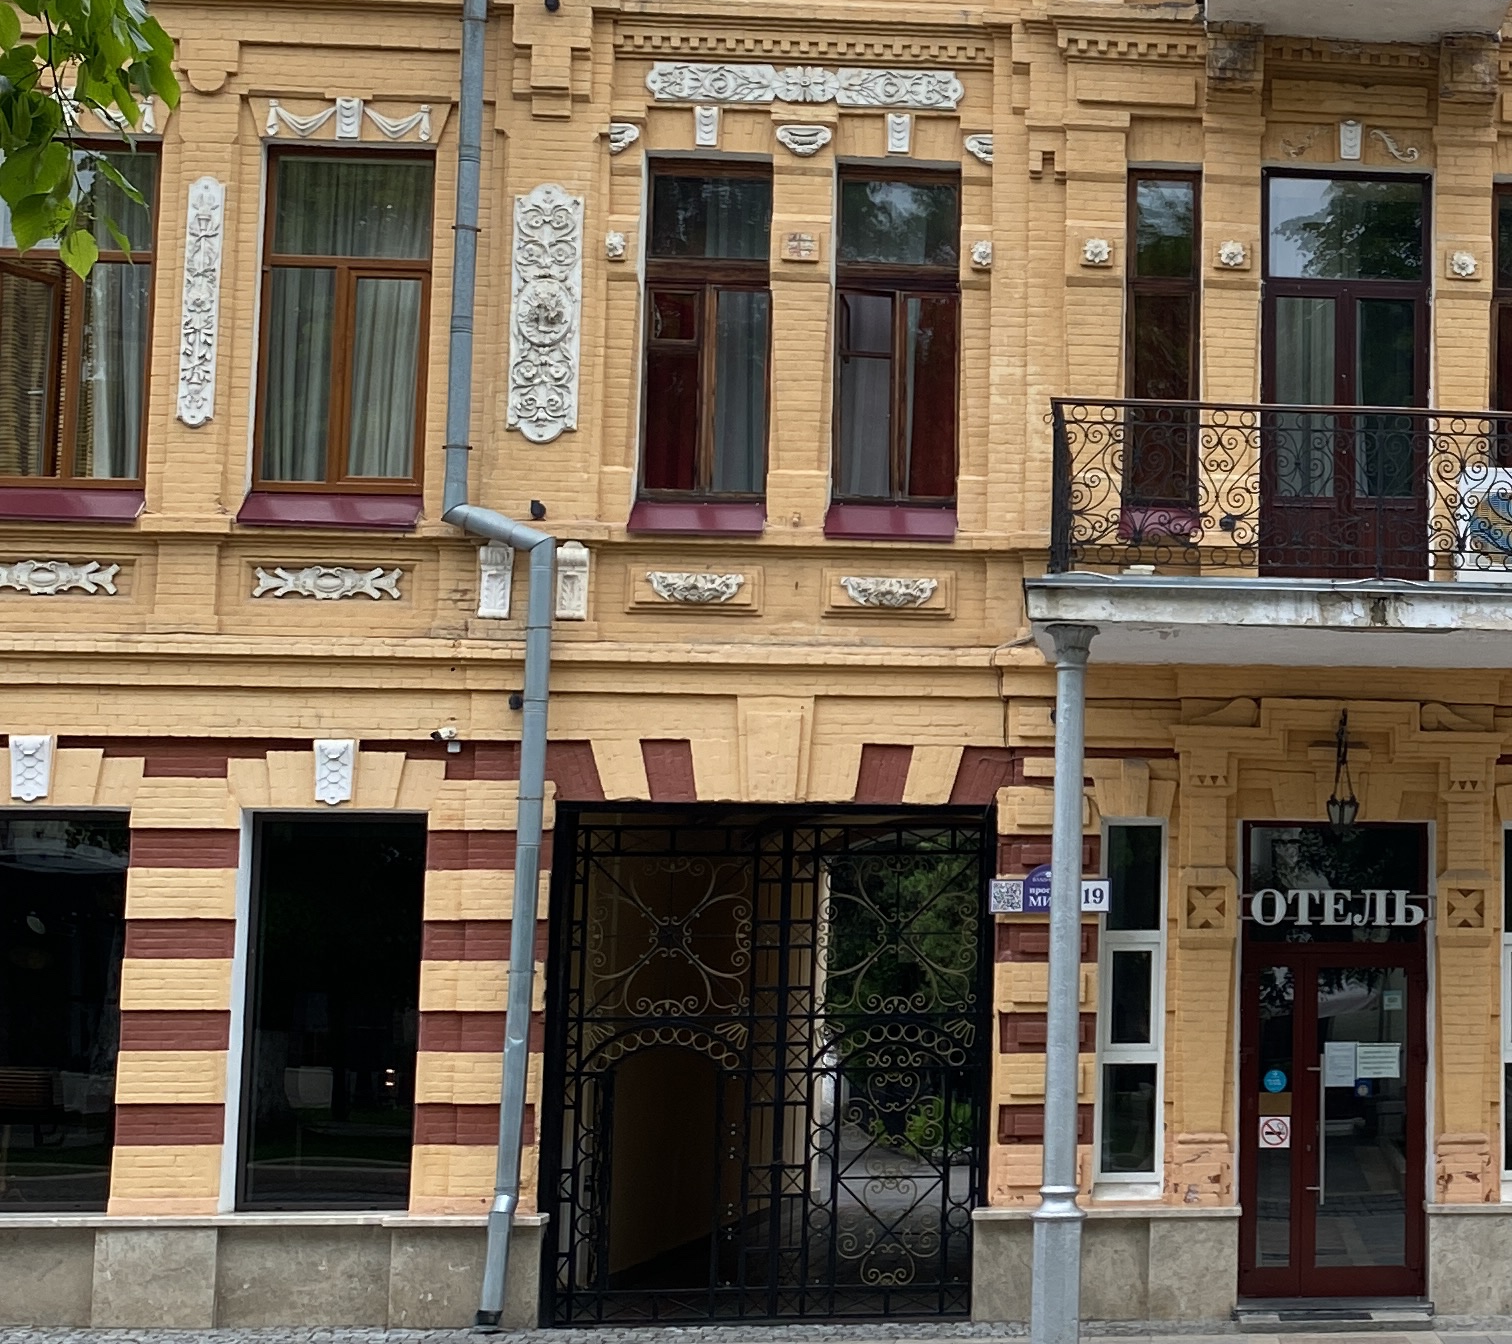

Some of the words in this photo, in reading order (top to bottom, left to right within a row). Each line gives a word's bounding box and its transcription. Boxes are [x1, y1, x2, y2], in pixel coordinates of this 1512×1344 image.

[1029, 887, 1051, 896] прос
[1083, 888, 1104, 904] 19
[1028, 895, 1052, 907] МИ
[1251, 888, 1425, 926] ОТЕЛЬ
